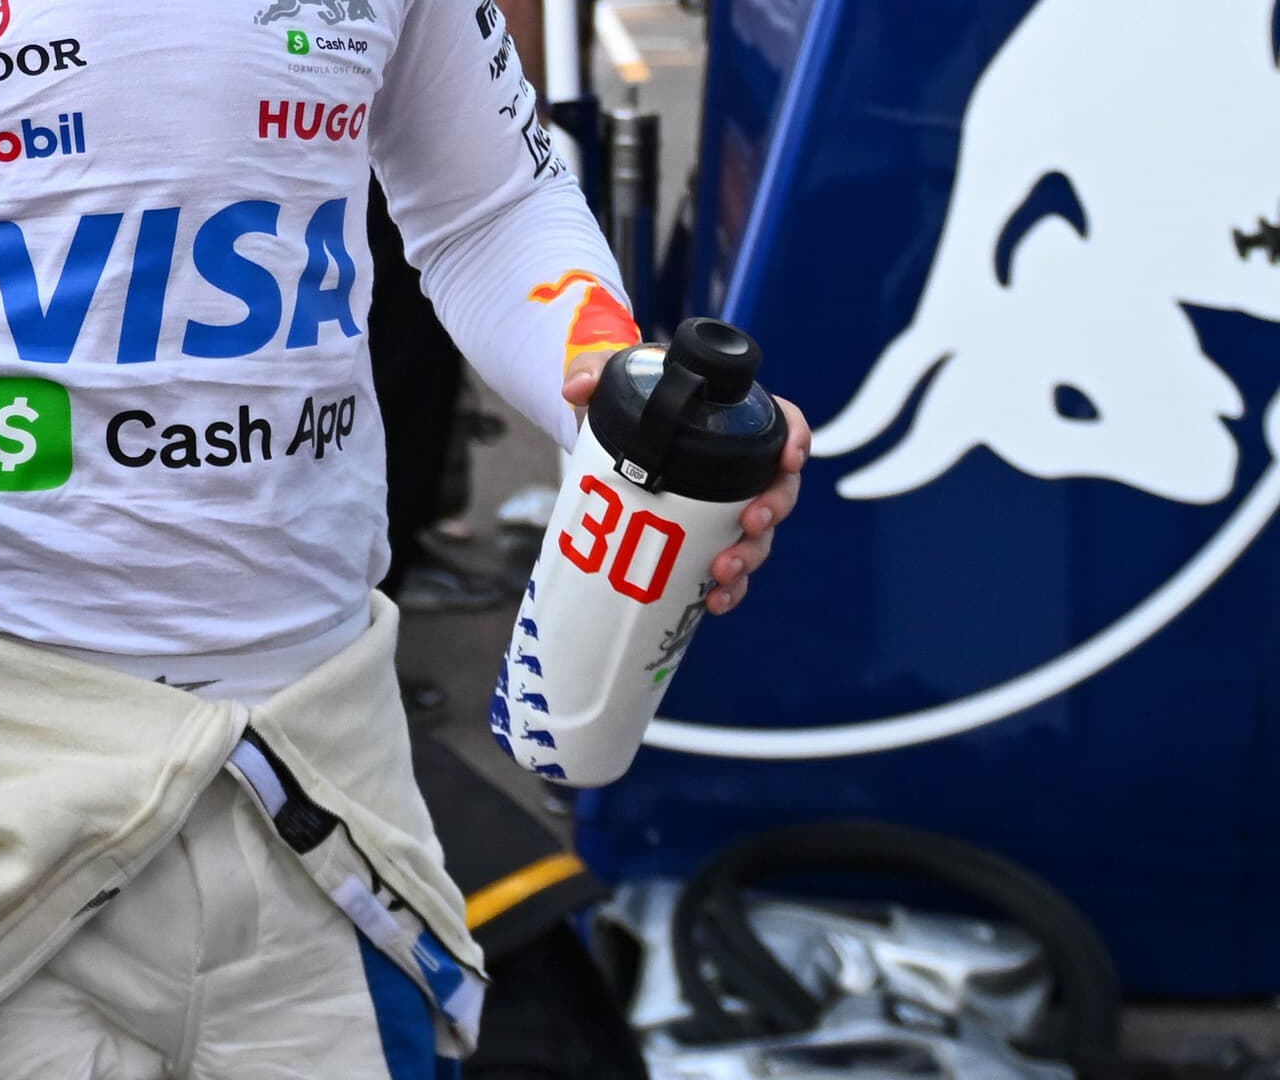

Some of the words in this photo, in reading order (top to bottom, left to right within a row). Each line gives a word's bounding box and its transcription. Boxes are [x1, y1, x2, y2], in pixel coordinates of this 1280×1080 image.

[315, 36, 346, 51] Cash
[347, 37, 368, 55] App
[257, 100, 367, 142] HUGO
[106, 405, 273, 470] Cash
[285, 394, 355, 460] App
[558, 474, 687, 605] 30
